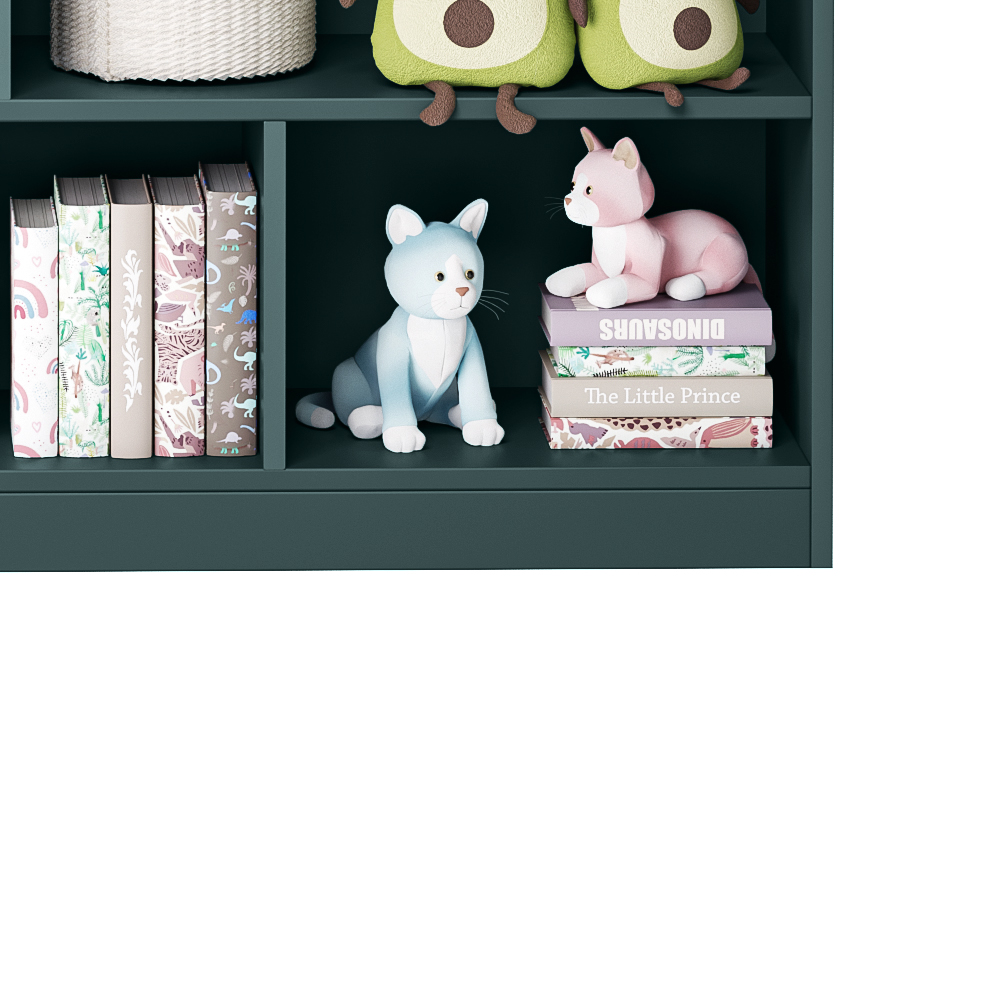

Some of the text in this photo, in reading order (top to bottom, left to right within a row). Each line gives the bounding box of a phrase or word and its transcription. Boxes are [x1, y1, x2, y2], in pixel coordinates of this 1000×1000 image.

[599, 318, 725, 340] DINOSAURS
[584, 386, 741, 404] The Little Prince
